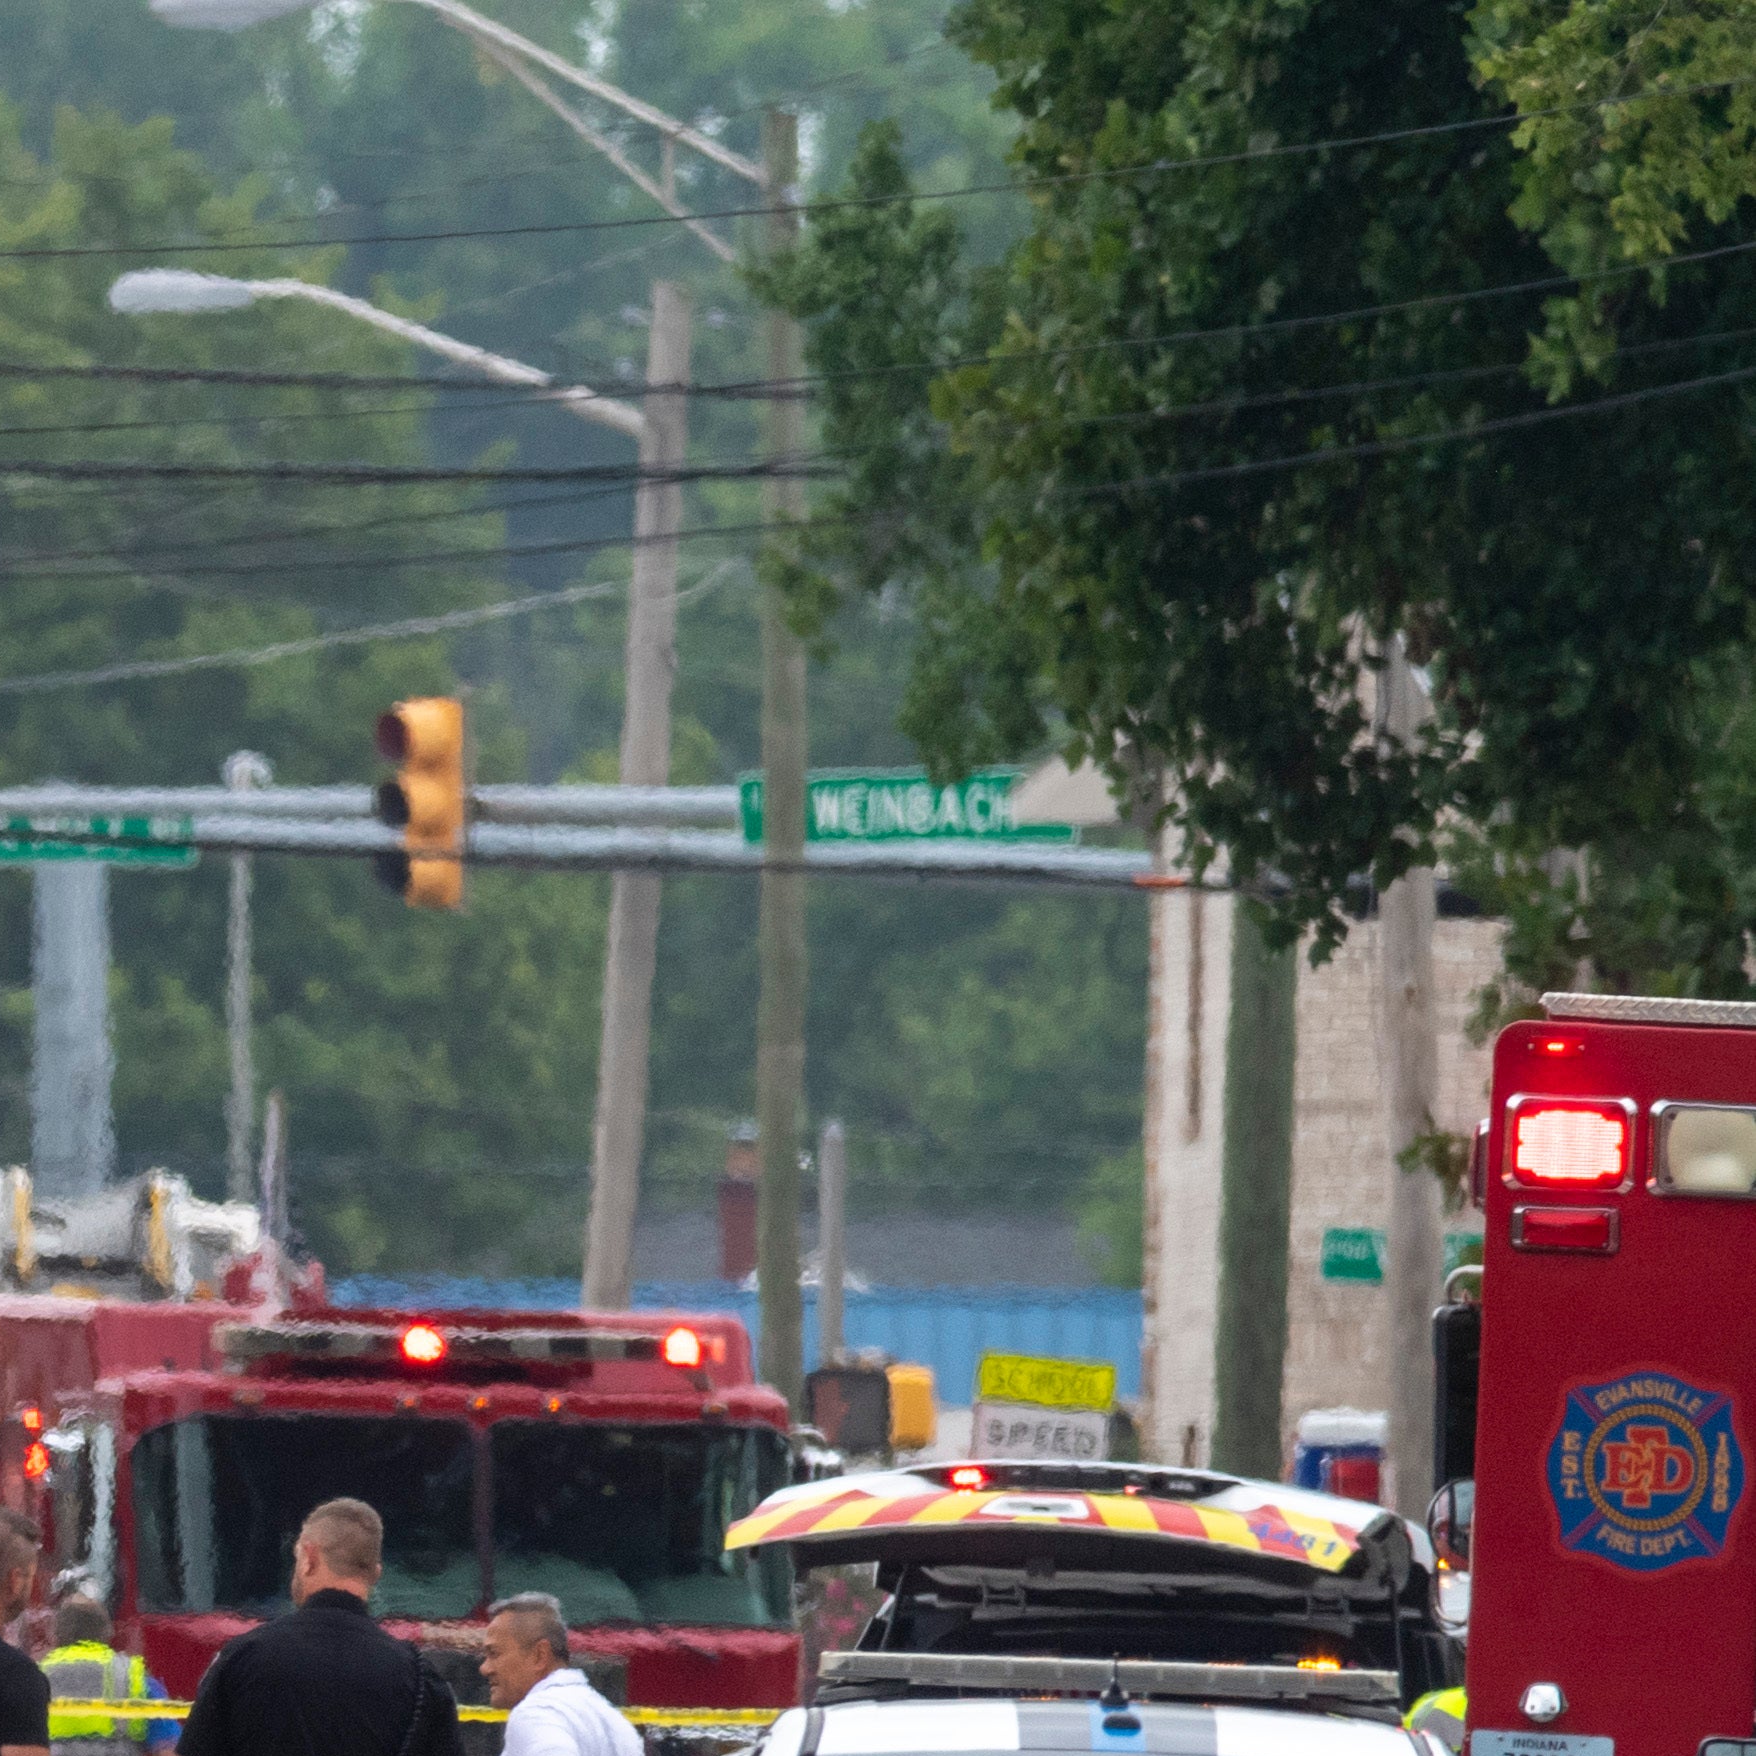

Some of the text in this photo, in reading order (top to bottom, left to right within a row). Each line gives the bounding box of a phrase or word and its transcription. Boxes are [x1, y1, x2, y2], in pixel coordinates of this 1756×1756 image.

[811, 783, 1018, 835] WEINBACH
[1594, 1379, 1703, 1415] EVANSVILLE
[987, 1418, 1098, 1456] SPEED
[1595, 1522, 1638, 1556] FIRE
[1511, 1737, 1569, 1751] INDIANA
